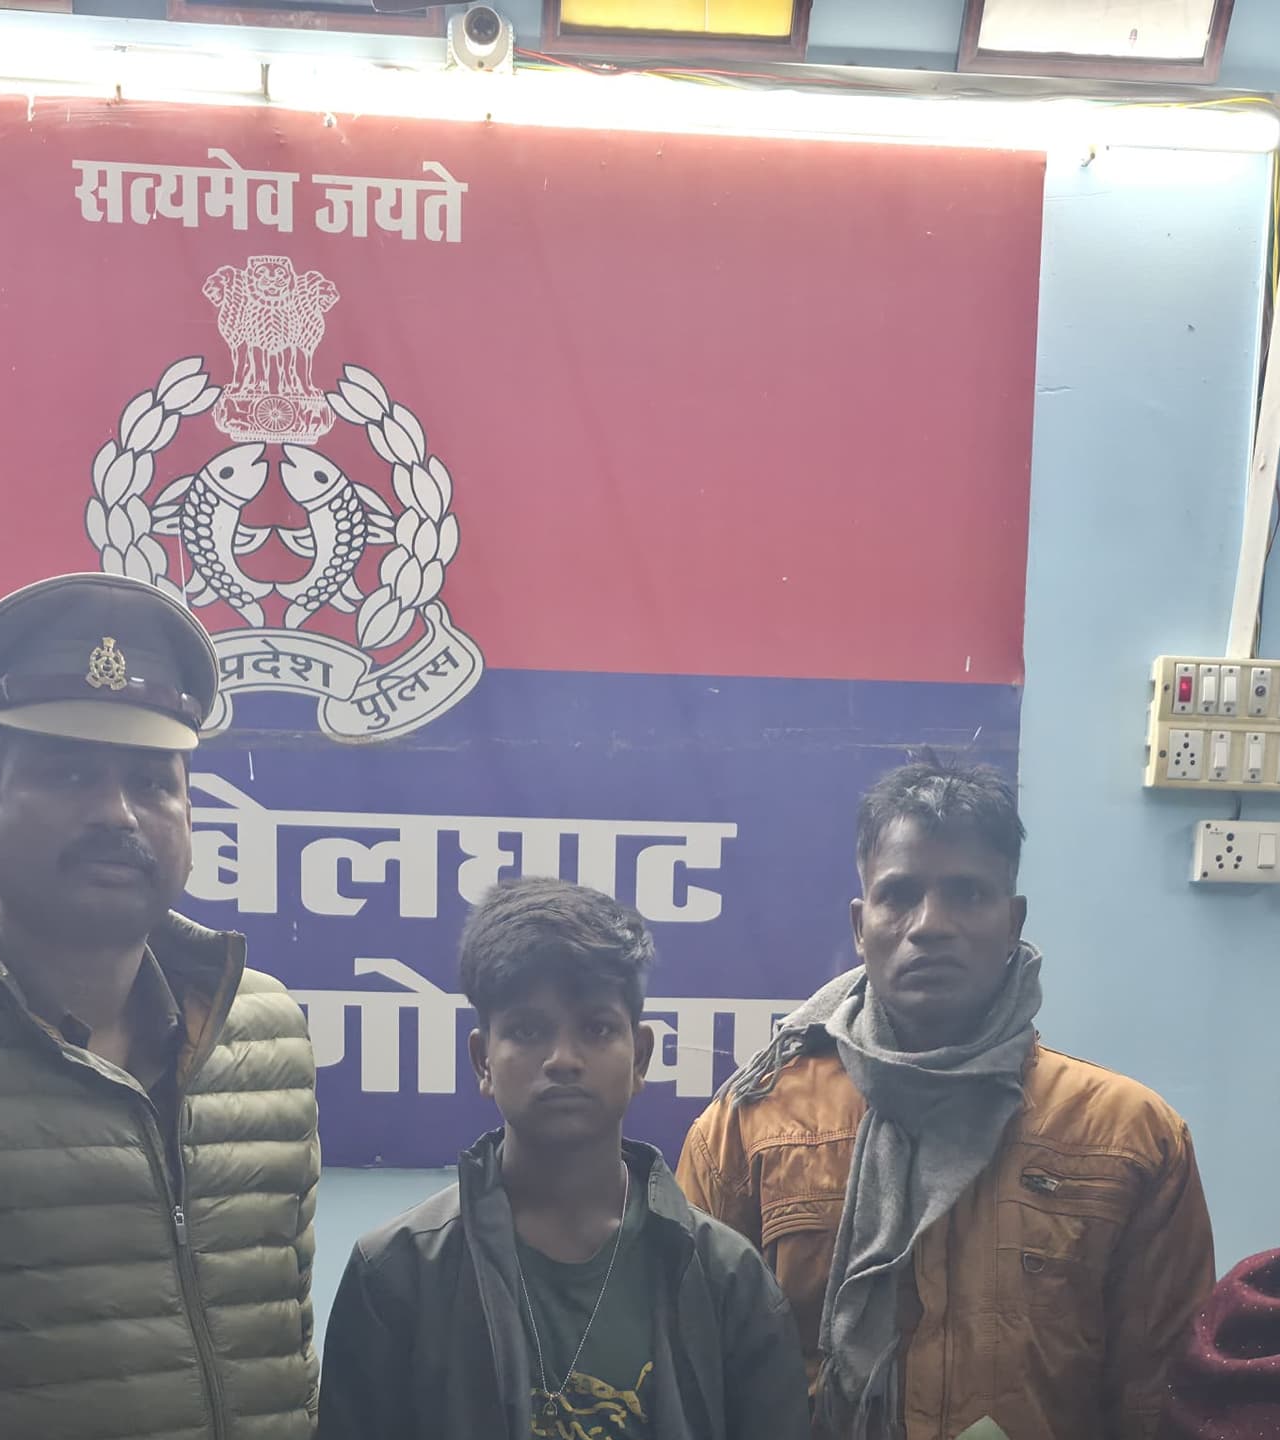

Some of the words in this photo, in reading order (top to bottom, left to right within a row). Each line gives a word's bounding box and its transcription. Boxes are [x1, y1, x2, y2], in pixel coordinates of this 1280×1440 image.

[72, 148, 300, 233] सत्यमेव
[312, 161, 468, 243] जयते
[219, 638, 334, 688] प्रदेश
[351, 646, 460, 730] पुलिस
